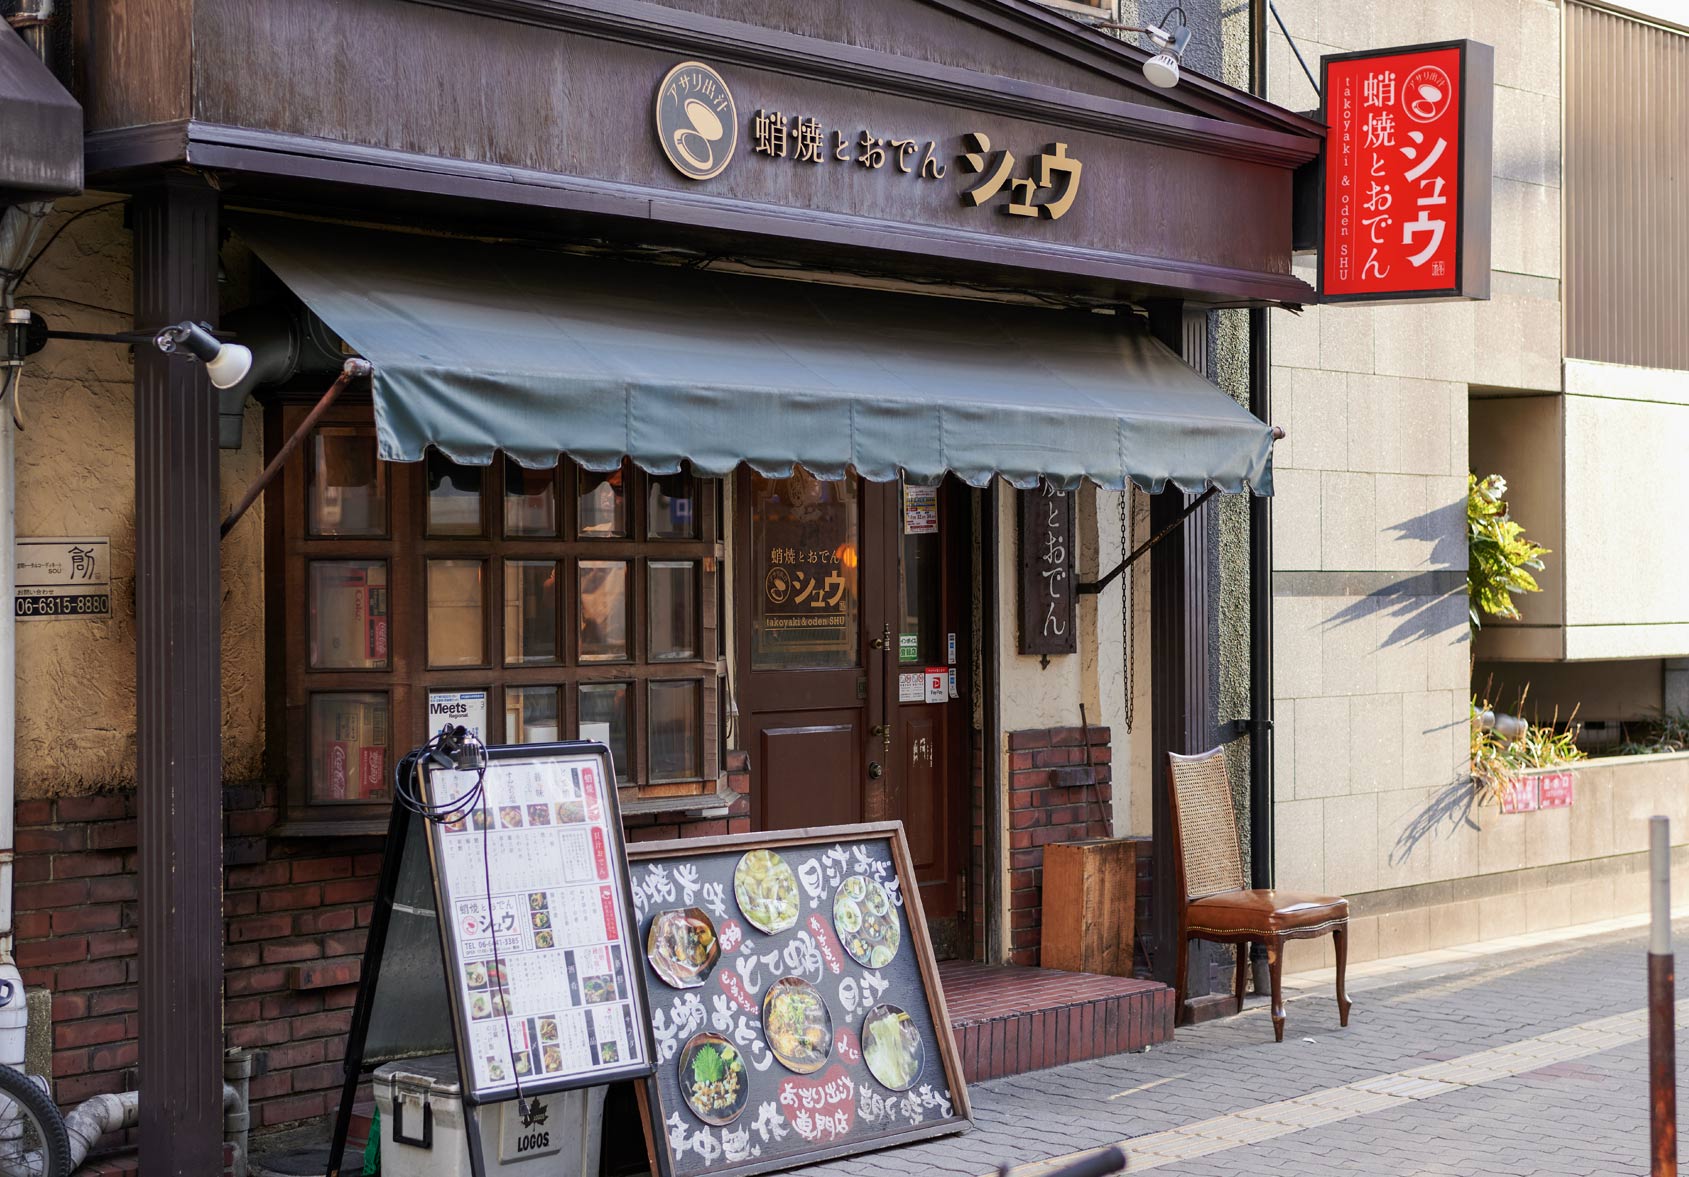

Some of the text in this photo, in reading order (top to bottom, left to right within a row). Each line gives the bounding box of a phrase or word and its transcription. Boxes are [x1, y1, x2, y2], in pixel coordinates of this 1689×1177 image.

[666, 72, 729, 114] アサリ出汁
[1409, 72, 1445, 89] アサリ出汁
[753, 109, 947, 180] 蛸焼とおでん
[958, 132, 1083, 220] シュウ
[1339, 77, 1351, 281] takoyaki & oden SHU
[1362, 70, 1396, 280] 蛸焼とおでん
[1400, 130, 1448, 267] シュウ
[771, 547, 840, 564] 蛸焼とおでん
[16, 596, 108, 615] 06-6315-8880
[792, 571, 845, 607] シュウ
[766, 618, 800, 629] takoyaki
[808, 616, 827, 626] oden
[829, 616, 845, 625] SHU
[430, 703, 467, 715] Meets
[479, 911, 516, 934] シュウ
[779, 1075, 855, 1109] あさり出汁
[517, 1131, 550, 1153] LOGOS
[792, 1108, 849, 1142] 専門店
